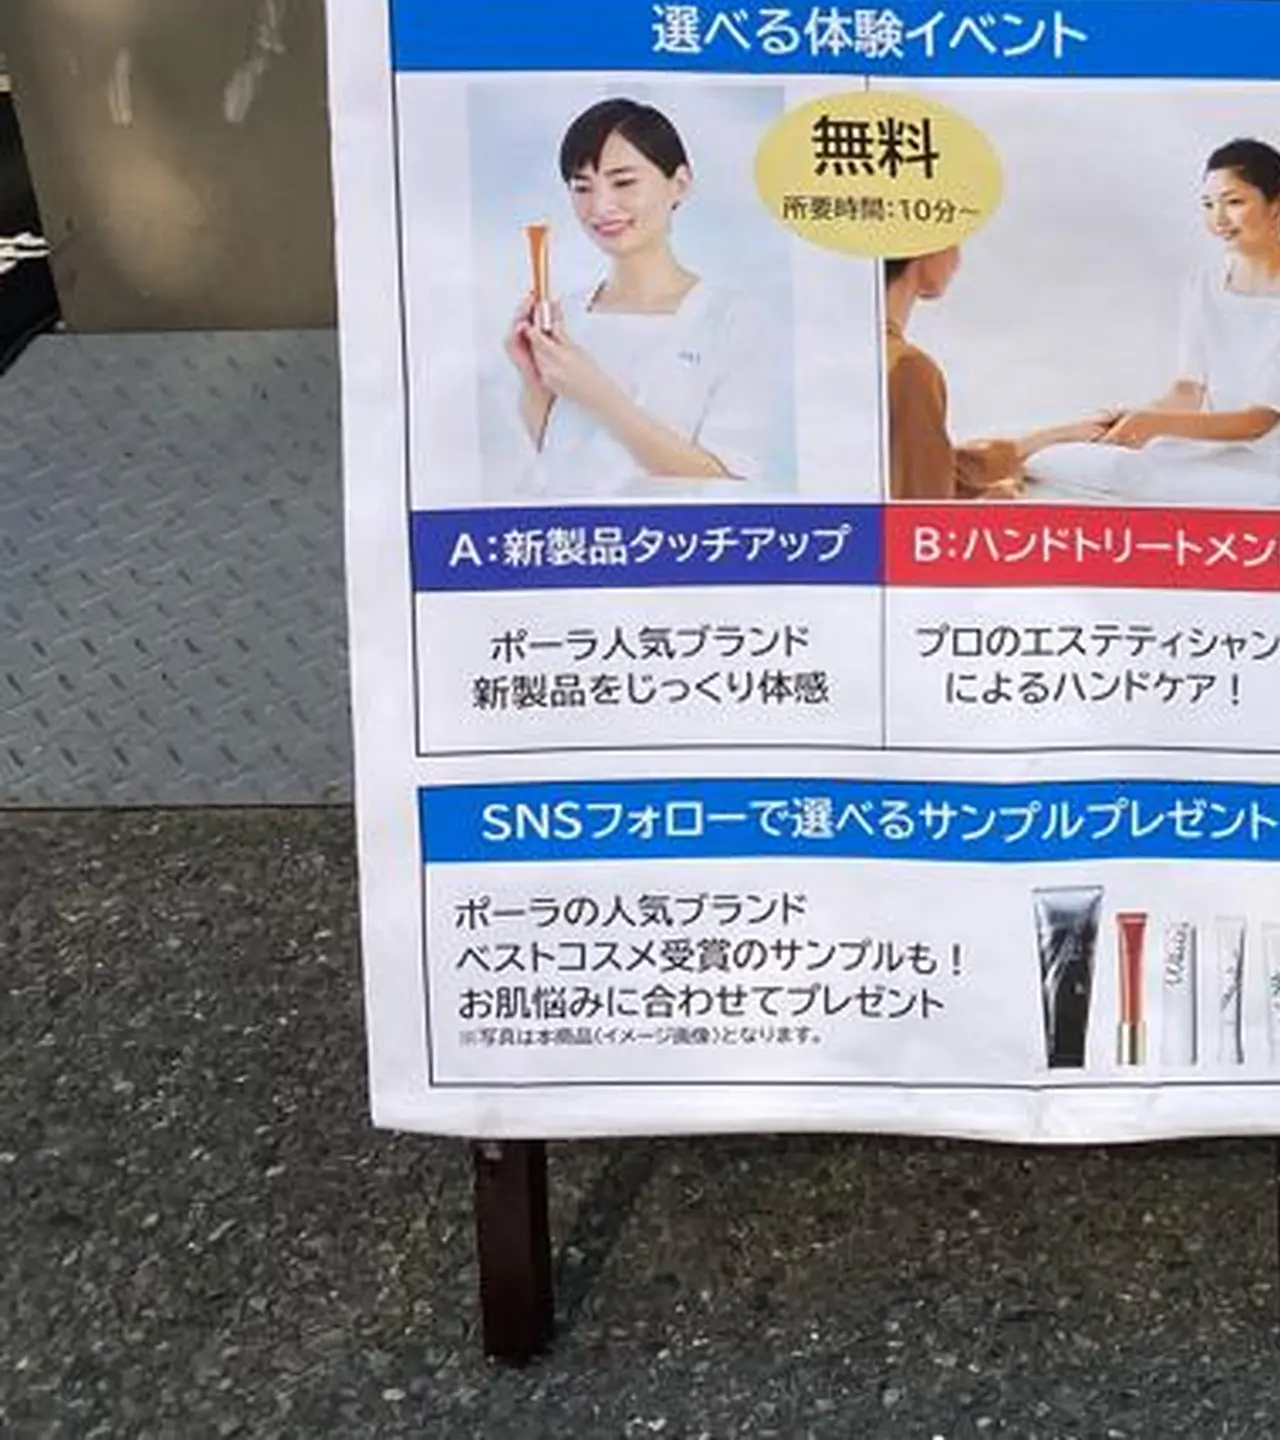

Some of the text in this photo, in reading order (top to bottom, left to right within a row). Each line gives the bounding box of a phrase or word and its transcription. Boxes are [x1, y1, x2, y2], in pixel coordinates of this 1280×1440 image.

[650, 2, 1087, 57] 選べる体験イベント
[812, 114, 940, 180] 無料
[490, 624, 810, 662] ポーラ人気ブランド
[472, 672, 830, 709] 新製品をじっくり体感
[944, 670, 1242, 707] によるハンドケア！
[481, 797, 1279, 843] SNSフォローで選べるサンプルプレゼント
[454, 892, 807, 930] ポーラの人気ブランド
[455, 939, 963, 976] ベストコスメ受賞のサンプルも！
[458, 984, 945, 1020] お肌悩みに合わせてプレゼント
